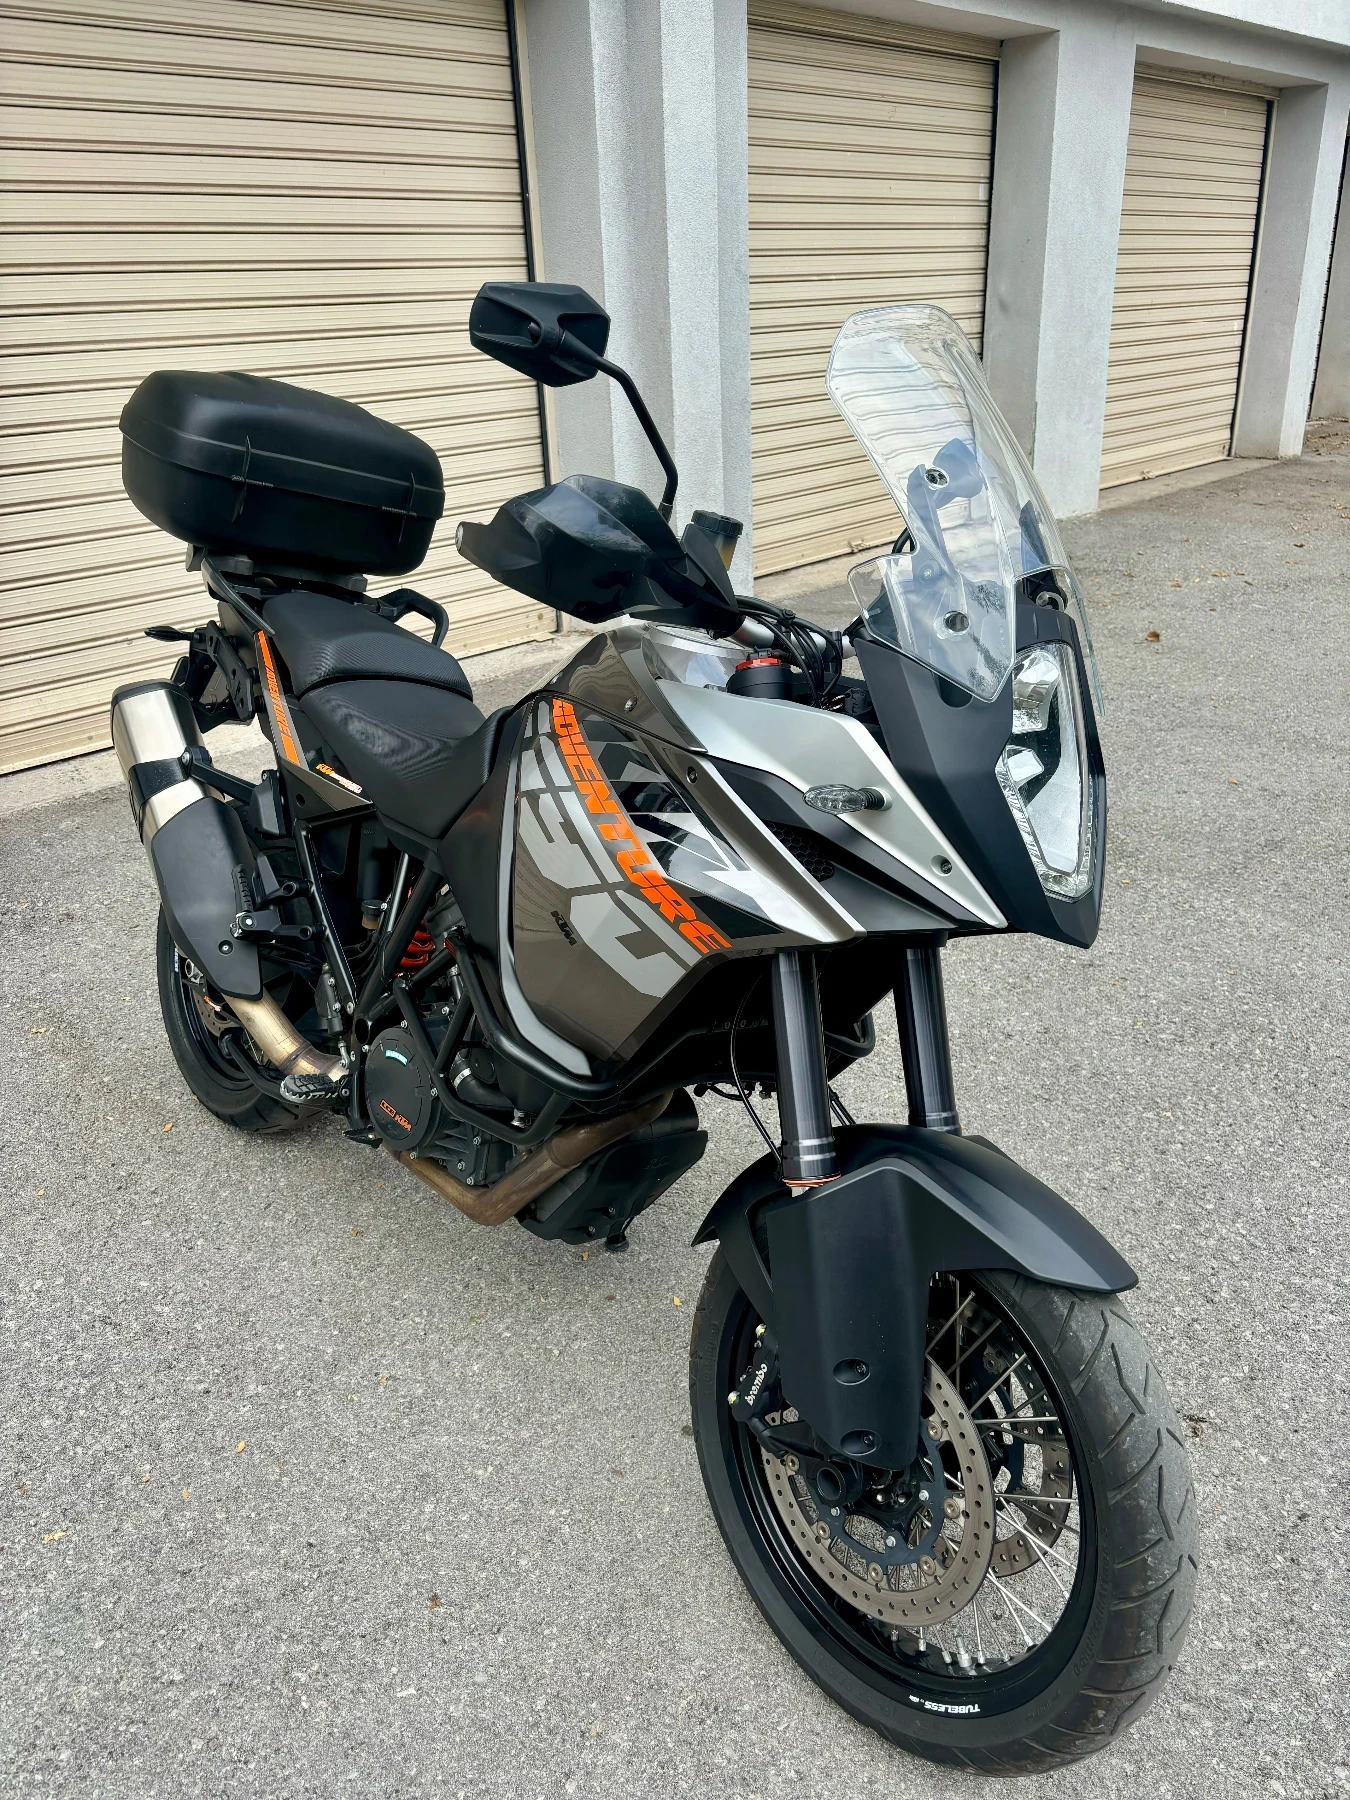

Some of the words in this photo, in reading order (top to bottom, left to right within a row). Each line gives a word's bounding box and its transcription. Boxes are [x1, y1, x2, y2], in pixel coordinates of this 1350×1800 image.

[552, 697, 733, 955] ADVENTURE
[550, 910, 577, 946] KTM
[745, 1363, 768, 1406] brembo
[924, 1701, 981, 1713] TUBELESS
